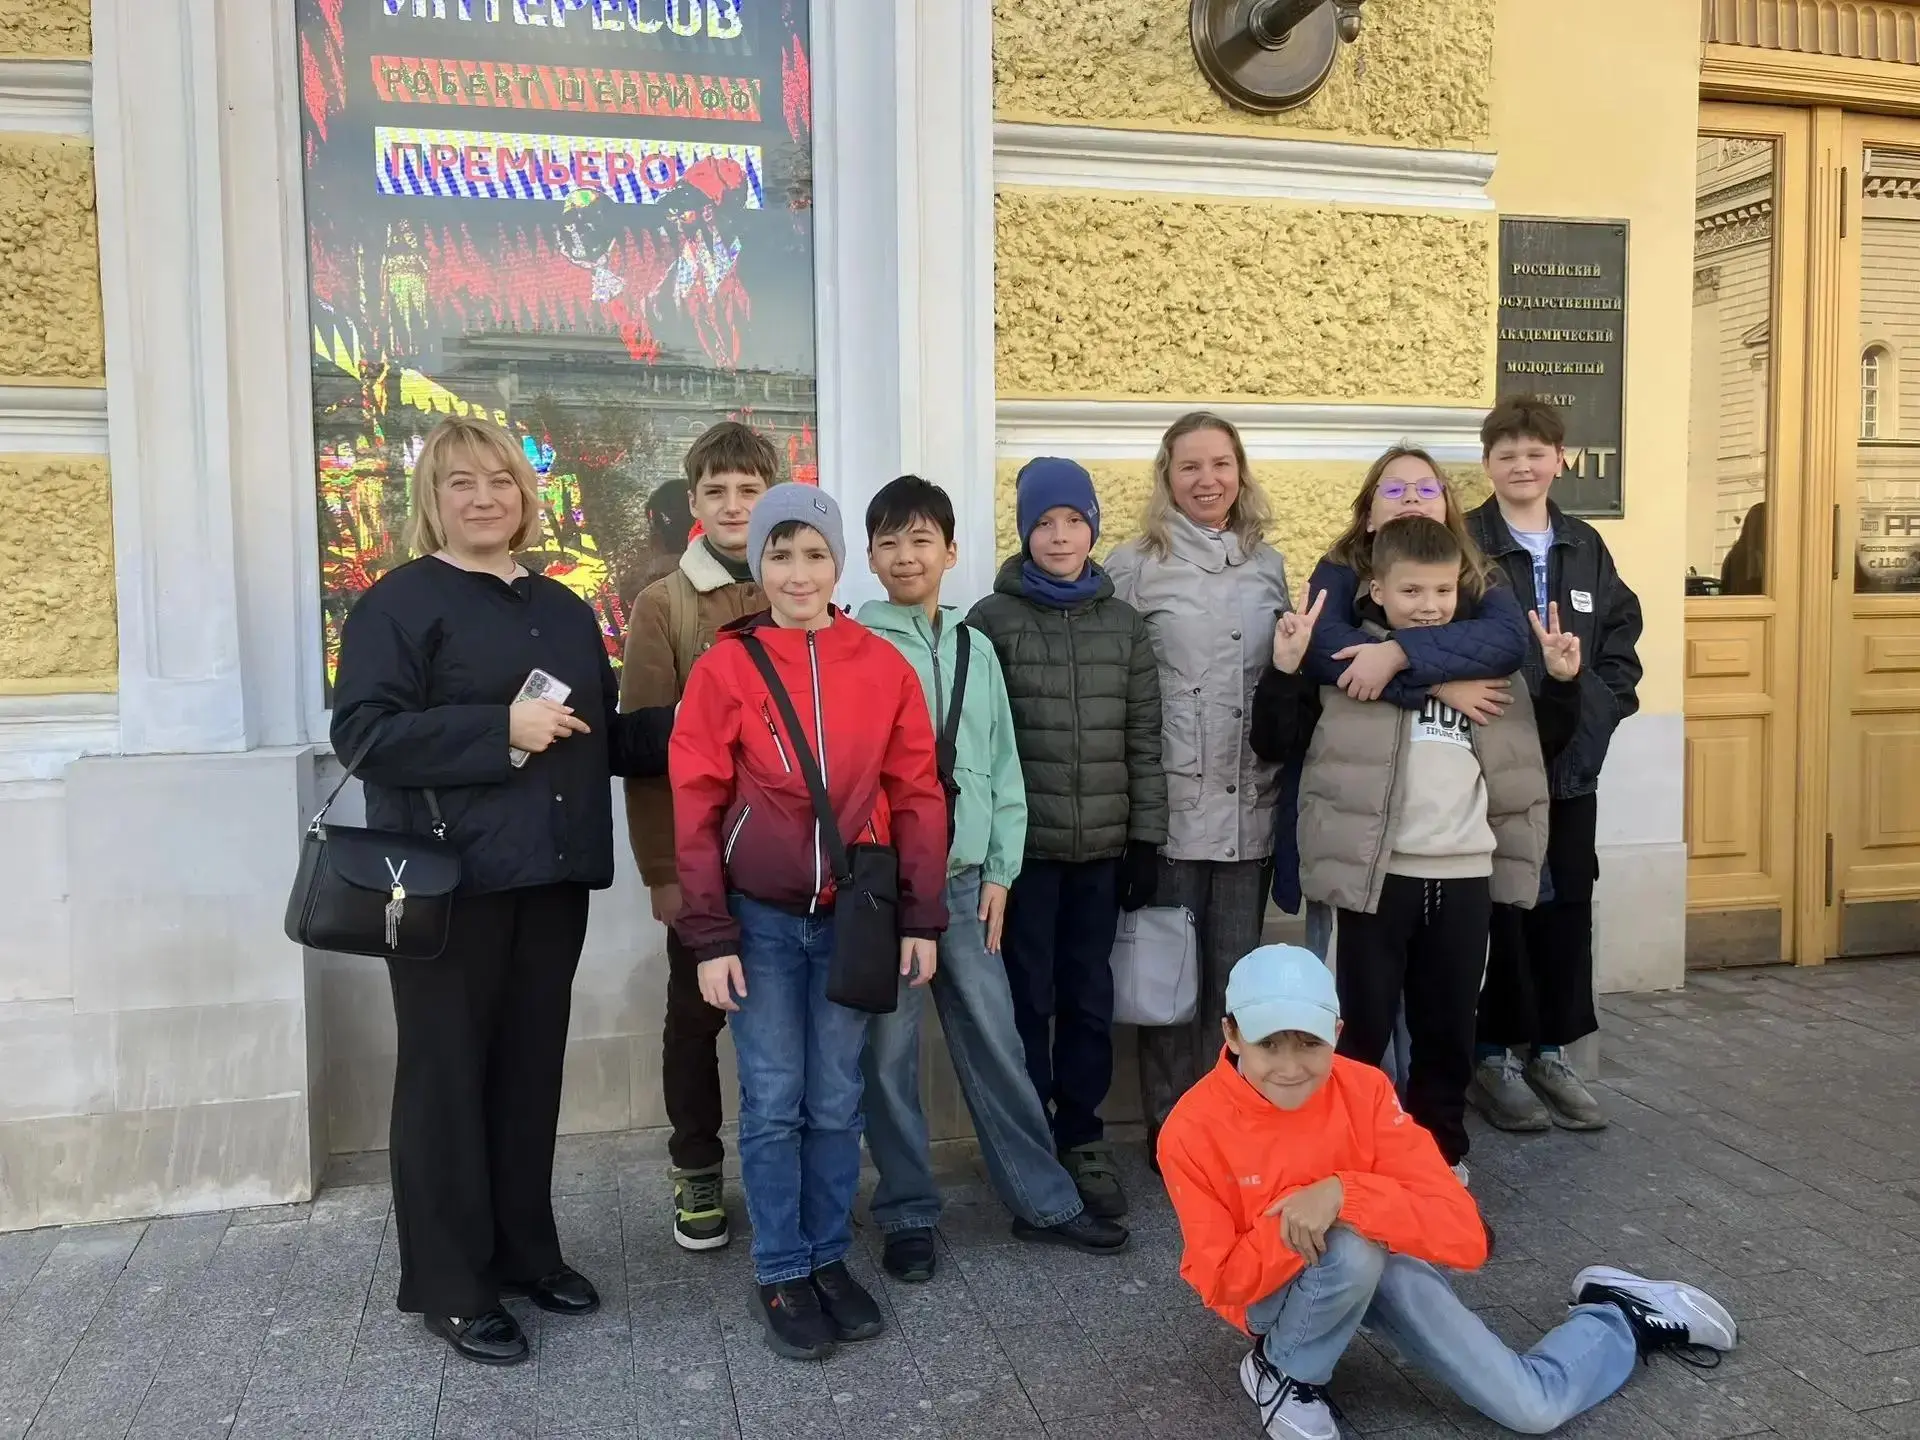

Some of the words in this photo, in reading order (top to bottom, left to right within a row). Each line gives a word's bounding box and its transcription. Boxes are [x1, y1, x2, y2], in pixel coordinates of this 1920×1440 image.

[384, 66, 537, 99] РОБЕРТ
[1512, 263, 1601, 277] РОССИЙСКИЙ
[1499, 295, 1622, 311] ОСУДАРСТВЕННЫЙ
[1498, 328, 1613, 343] АКАДЕМИЧЕСКИЙ
[1505, 360, 1605, 375] МОЛОДЕЖНЫЙ
